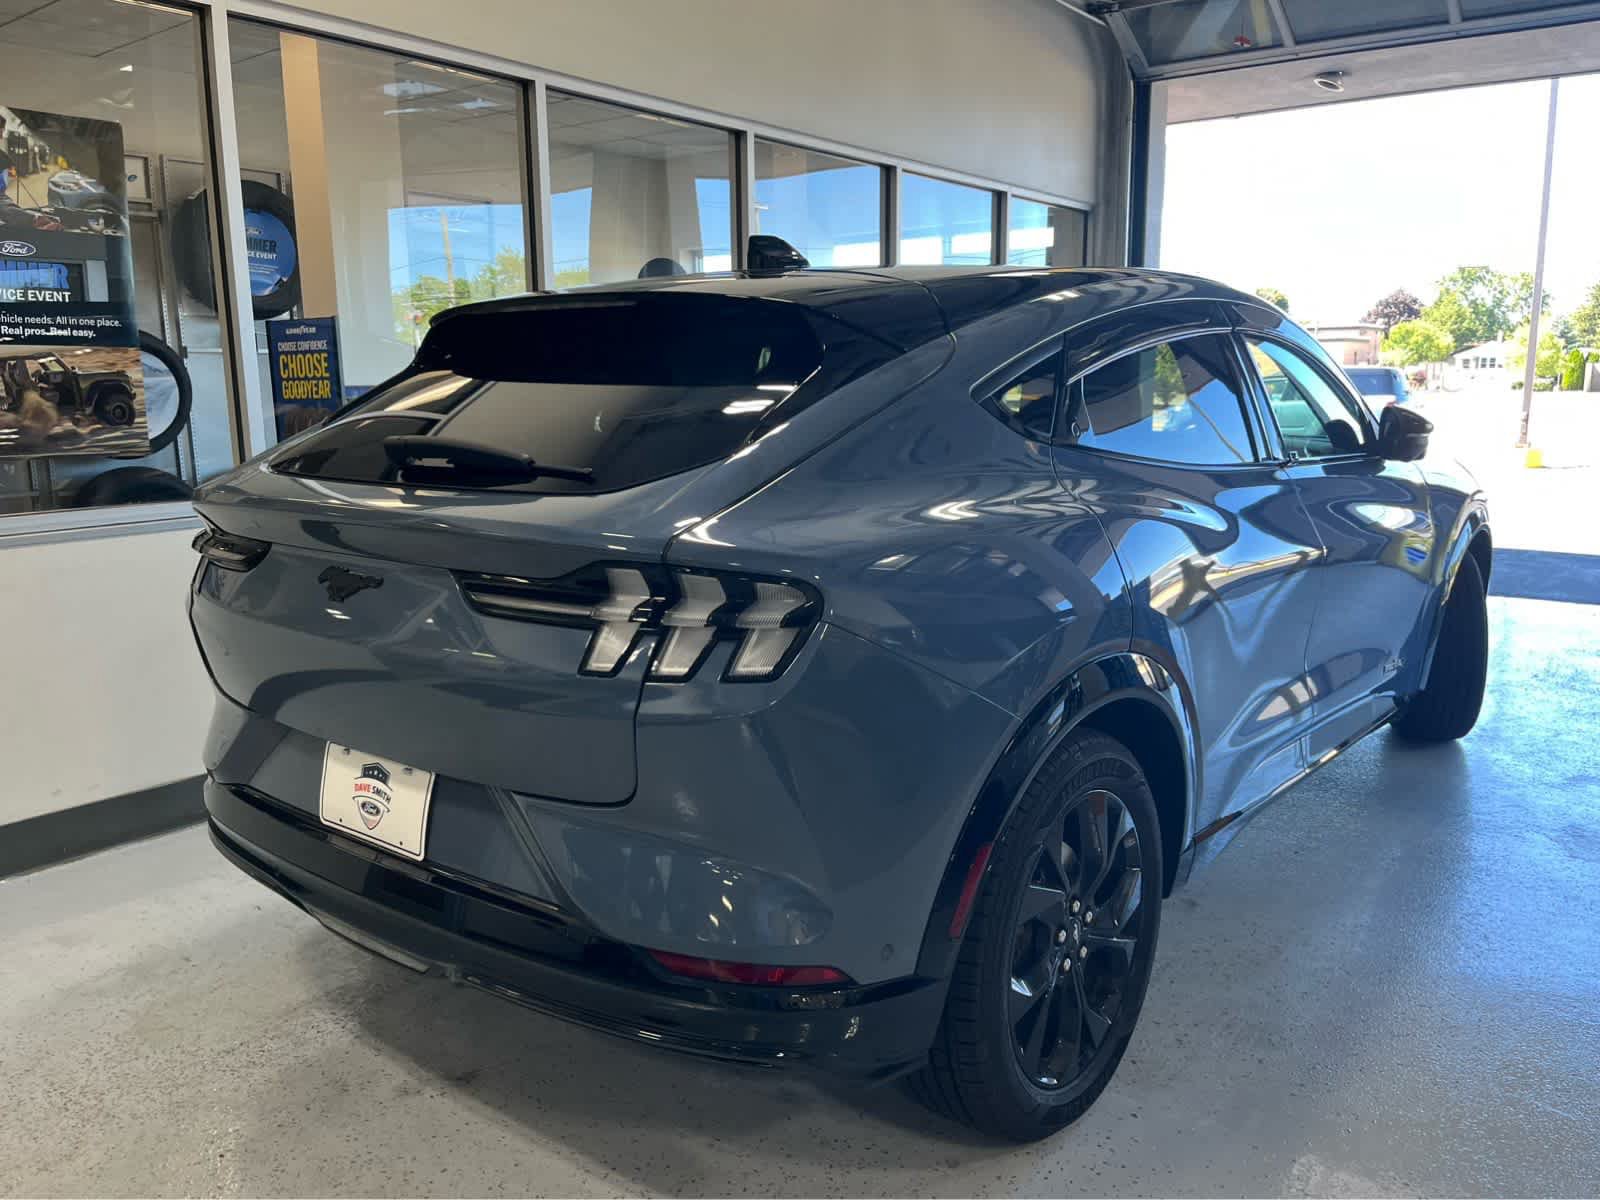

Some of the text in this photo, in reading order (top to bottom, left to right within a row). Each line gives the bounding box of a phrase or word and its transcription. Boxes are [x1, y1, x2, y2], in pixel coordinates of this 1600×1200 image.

[2, 243, 28, 254] Ford
[0, 289, 71, 303] ICE EVENT
[0, 313, 23, 324] hicle
[24, 314, 55, 325] needs.
[56, 316, 68, 325] All
[69, 316, 78, 325] in
[97, 318, 122, 328] place.
[1, 325, 23, 335] Real
[72, 330, 96, 338] easy.
[277, 340, 328, 352] CHOOSE CONFIDENCE
[280, 352, 330, 379] CHOOSE
[282, 379, 332, 399] GOODYEAR
[354, 783, 392, 805] DAVE SMITH
